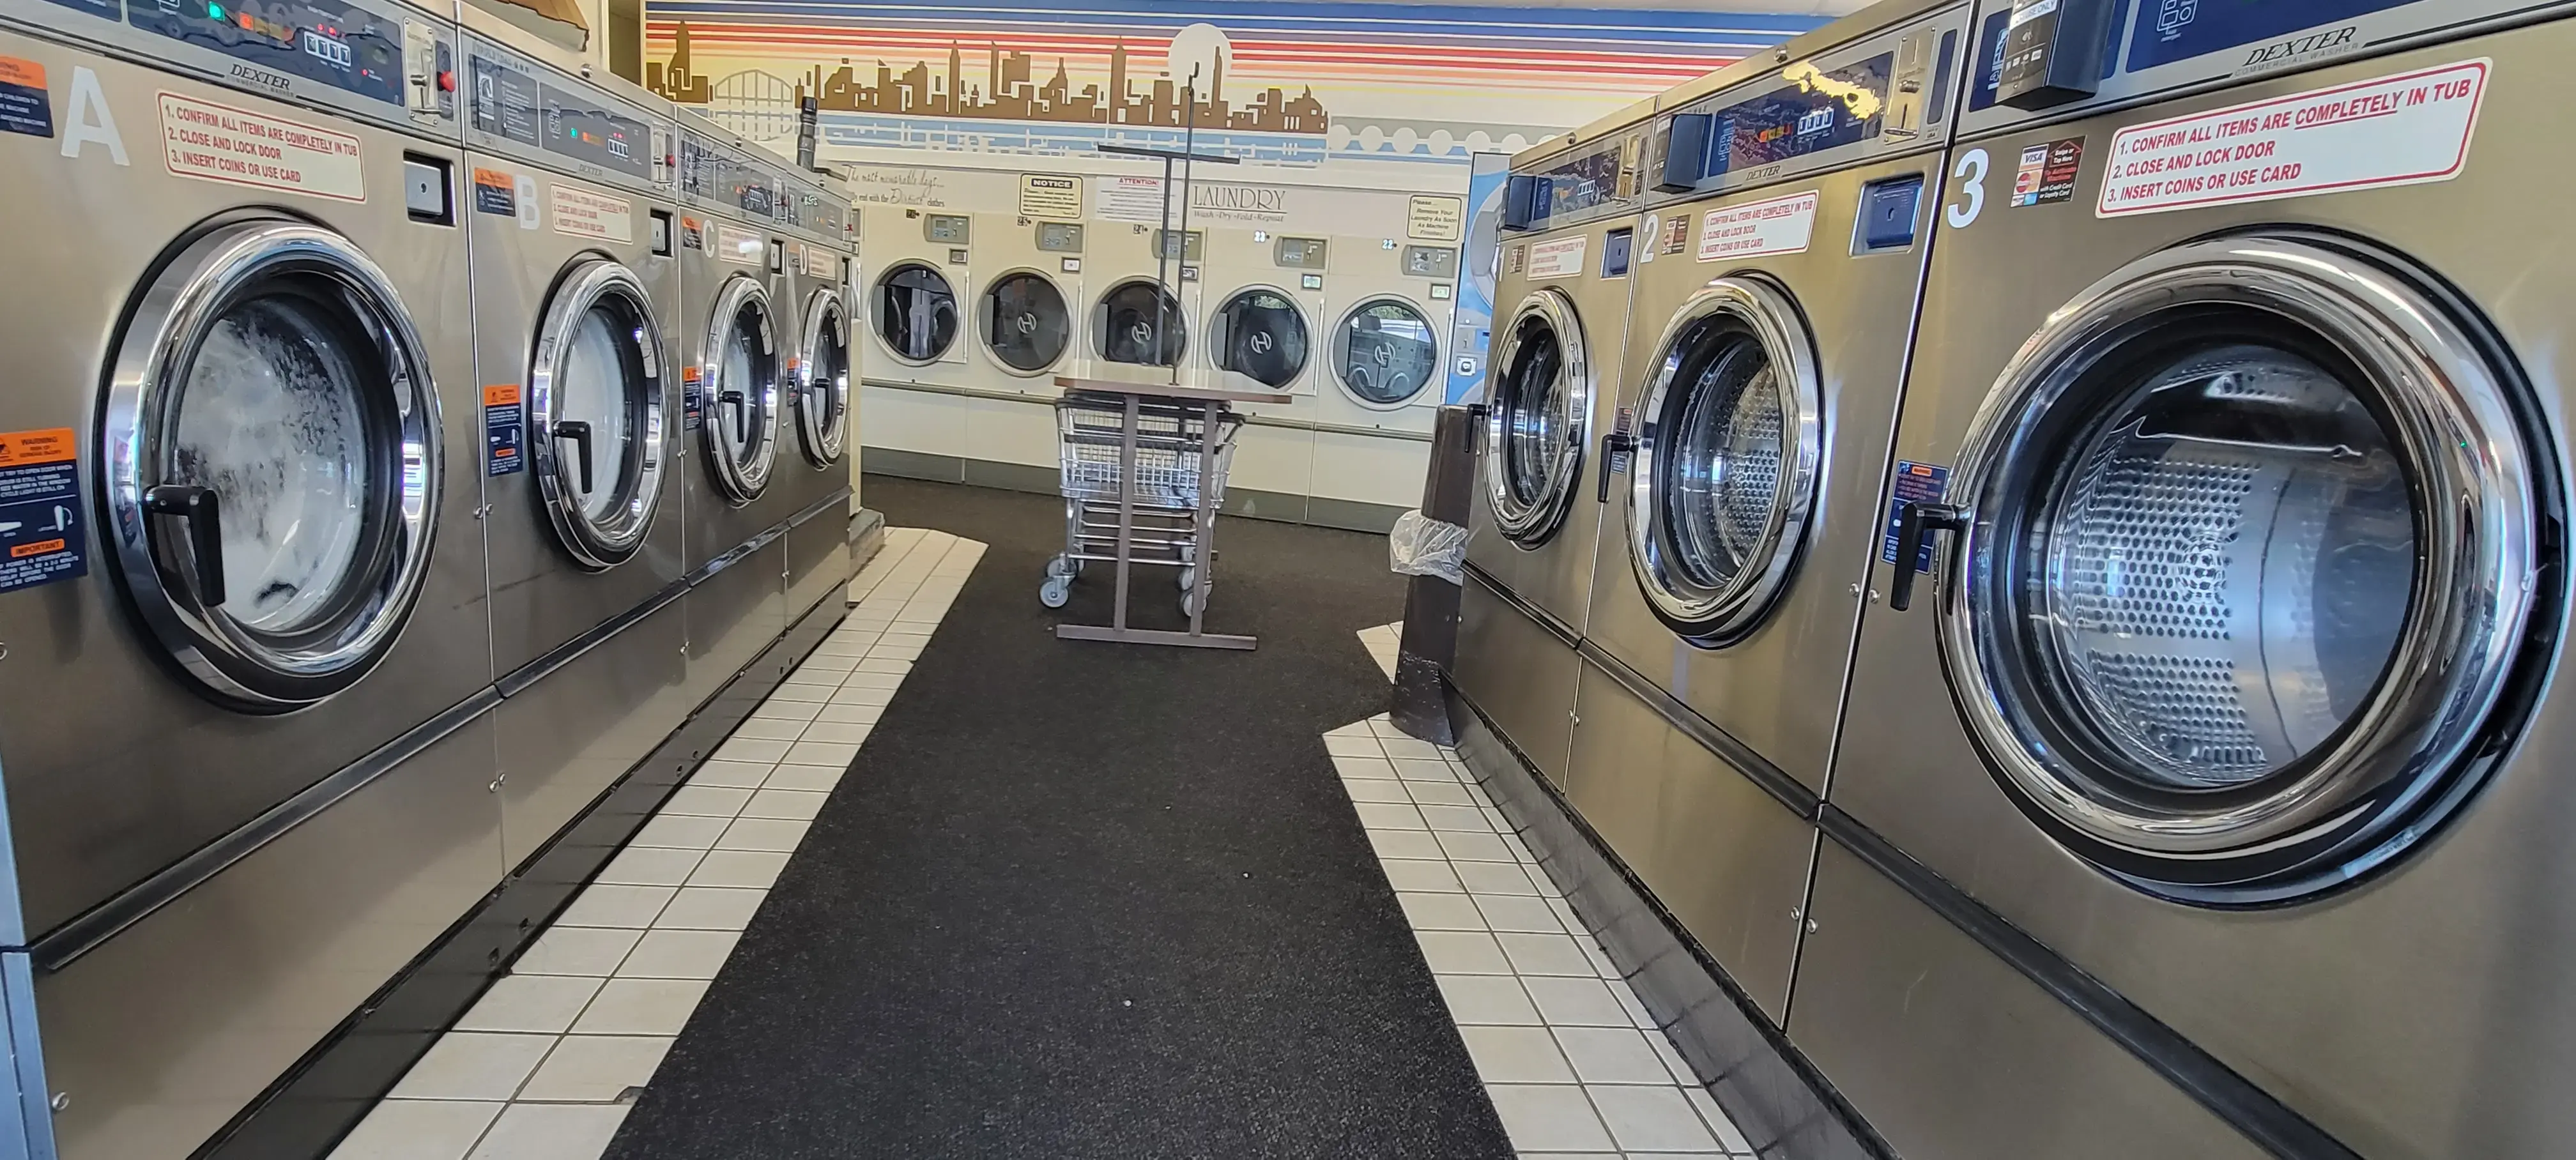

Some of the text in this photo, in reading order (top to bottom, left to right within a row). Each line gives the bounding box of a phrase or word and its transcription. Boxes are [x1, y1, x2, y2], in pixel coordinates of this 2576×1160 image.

[2234, 43, 2358, 75] COMMERCIAL WASHER
[2242, 26, 2356, 66] DEXTER
[231, 63, 290, 90] DEXTER
[61, 66, 130, 166] A
[166, 104, 358, 156] 1. CONFIRM ALL ITEMS ARE COMPLETELY IN TUB
[2120, 79, 2471, 156] 1. CONFIRM ALL ITEMS ARE COMPLETELY IN TUB
[169, 126, 282, 160] 2. CLOSE AND LOCK DOOR
[2025, 153, 2042, 163] VISA
[171, 149, 301, 183] 3. INSERT COINS OR USE CARD
[1746, 165, 1780, 181] DEXTER
[2112, 141, 2276, 179] 2. CLOSE AND LOCK DOOR
[1033, 179, 1071, 188] NOTICE
[1194, 186, 1285, 210] LAUNDRY
[1947, 148, 1989, 229] 3
[2108, 164, 2301, 202] 3. INSERT COINS OR USE CARD
[516, 174, 540, 230] B
[1710, 216, 1728, 225] CONFIRM
[1738, 211, 1751, 221] ITEMS
[1752, 210, 1762, 218] ARE
[1762, 204, 1793, 220] COMPLETELY
[1795, 202, 1801, 211] IN
[1802, 201, 1813, 211] TUB
[703, 219, 714, 258] C
[1382, 239, 1393, 250] 22
[1640, 215, 1658, 263] 2
[1705, 244, 1719, 253] INSERT
[1720, 242, 1733, 252] COINS
[1734, 241, 1740, 250] OR
[1740, 240, 1751, 249] USE
[1751, 238, 1763, 247] CARD
[1707, 229, 1721, 239] CLOSE
[1721, 229, 1730, 238] AND
[1731, 227, 1742, 236] LOCK
[1743, 225, 1757, 234] DOOR
[800, 244, 808, 275] D
[16, 541, 59, 554] IMPORTANT
